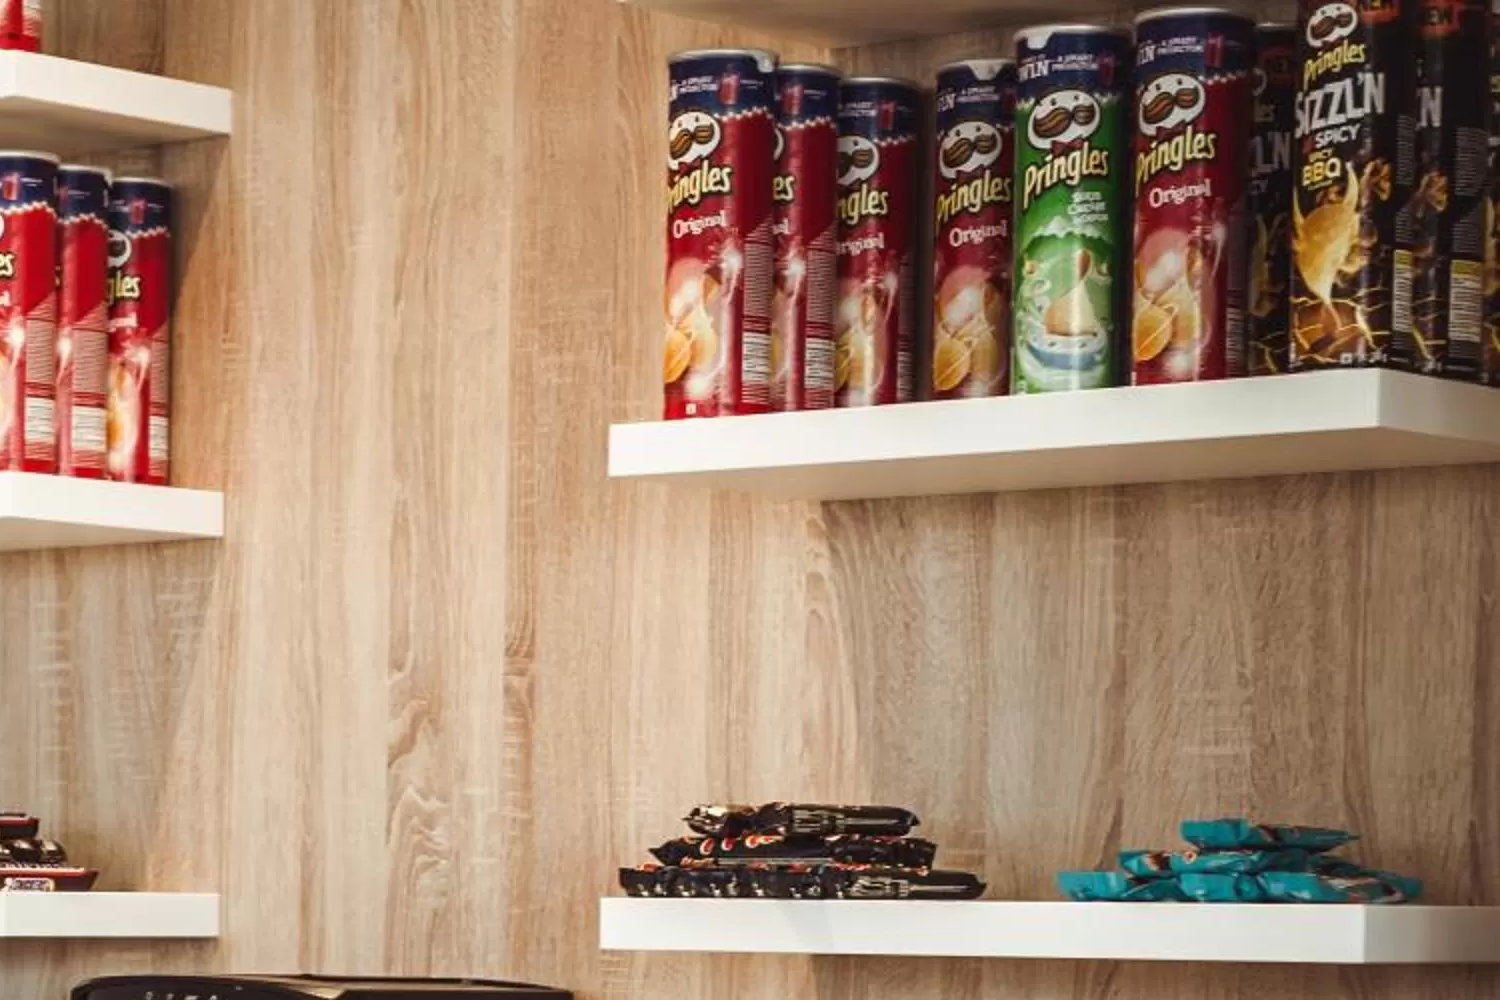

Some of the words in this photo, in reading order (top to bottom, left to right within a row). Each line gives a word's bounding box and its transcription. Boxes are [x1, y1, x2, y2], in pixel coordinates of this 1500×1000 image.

[1315, 123, 1361, 148] SPICY
[1023, 140, 1108, 210] Pringles
[1135, 125, 1217, 197] Pringles
[1303, 157, 1341, 187] BBQ
[665, 160, 732, 214] ringles
[936, 169, 1012, 231] Pringles
[1150, 178, 1212, 208] Original
[672, 209, 727, 238] Original
[950, 219, 1009, 247] Original
[837, 232, 885, 256] riginal
